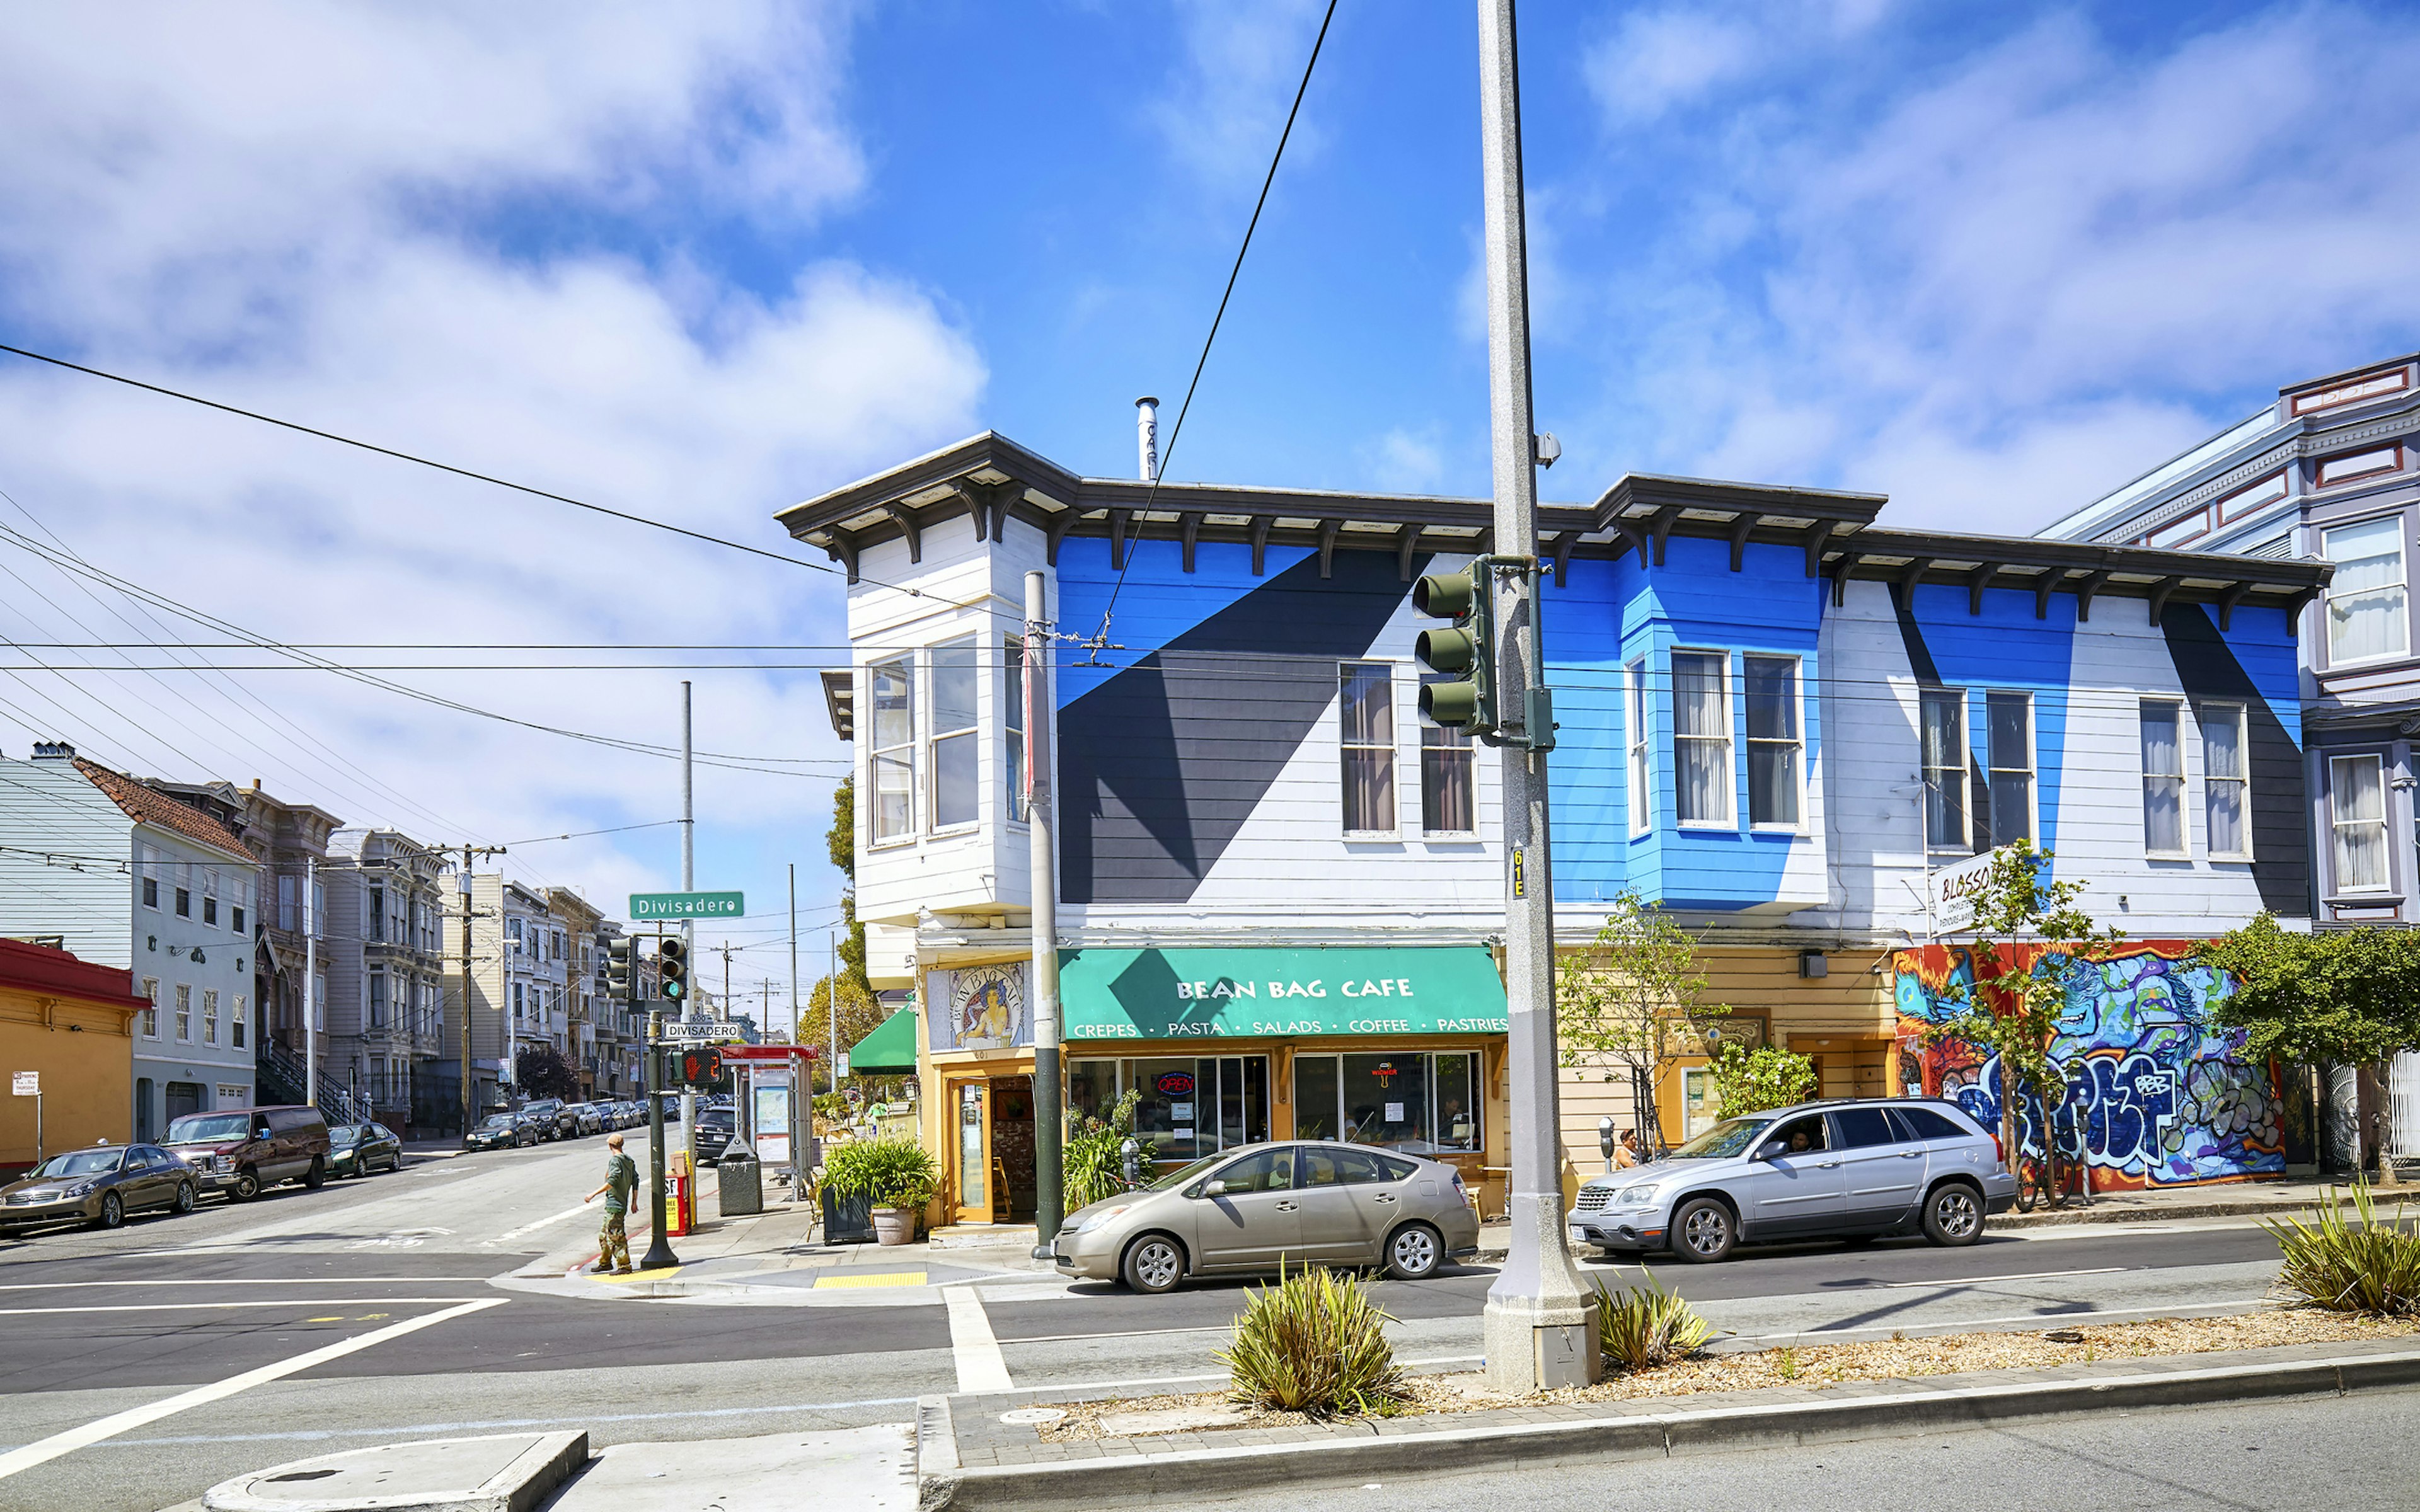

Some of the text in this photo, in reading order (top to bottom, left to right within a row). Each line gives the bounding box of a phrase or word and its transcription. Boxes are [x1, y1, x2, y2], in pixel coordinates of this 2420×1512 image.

[1514, 850, 1523, 896] 61E
[1942, 866, 1994, 902] BLOSSO
[639, 898, 735, 914] Divisadero
[1176, 978, 1414, 999] BEAN BAG CAFE
[670, 1027, 736, 1035] DIVISADERO
[1074, 1017, 1509, 1038] CREPES PASTA SALADS COFFEE PASTRIES
[710, 1056, 719, 1077] 2
[1158, 1077, 1194, 1091] OPEN
